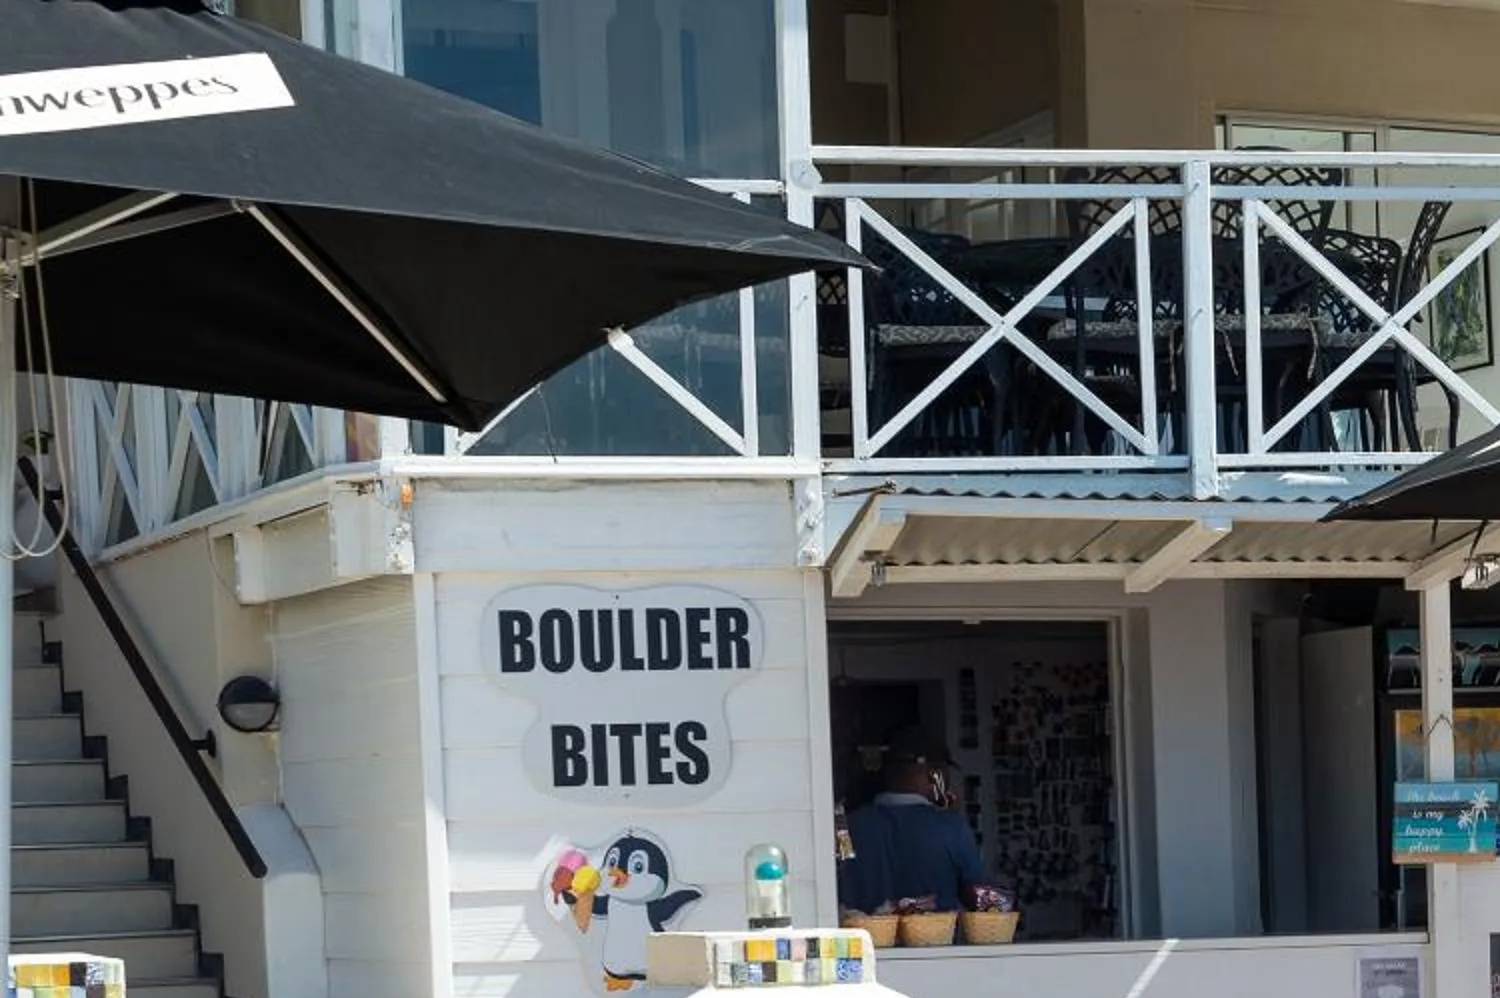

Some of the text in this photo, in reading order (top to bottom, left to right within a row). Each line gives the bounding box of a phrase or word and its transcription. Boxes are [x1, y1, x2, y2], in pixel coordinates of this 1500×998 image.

[498, 606, 751, 673] BOULDER
[551, 720, 710, 787] BITES
[1404, 823, 1443, 839] happy
